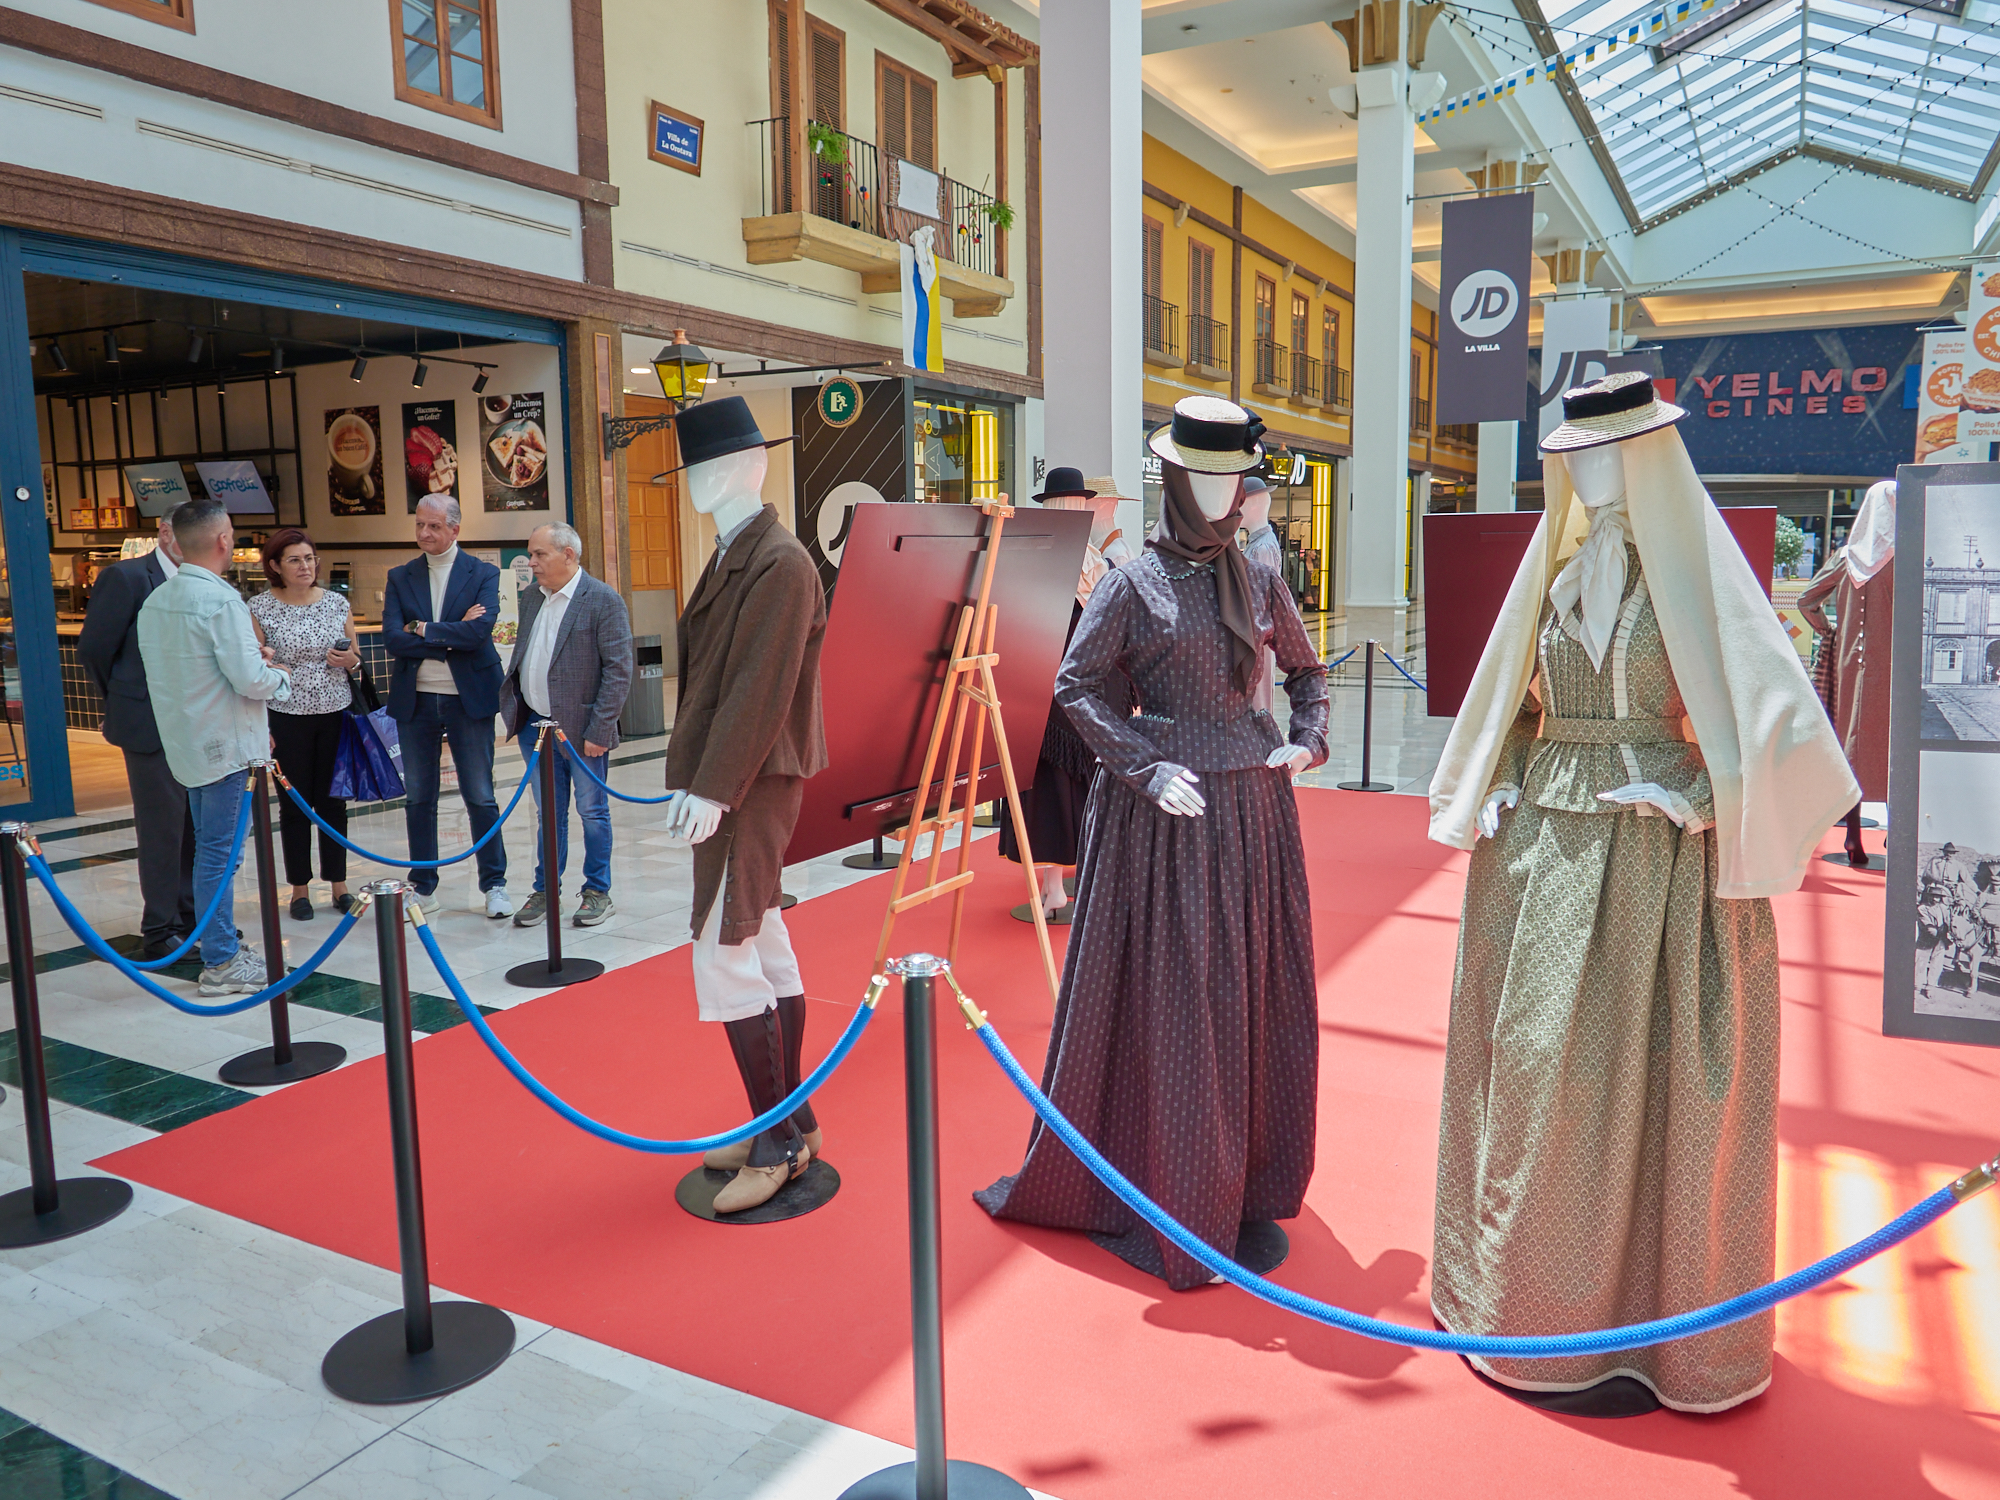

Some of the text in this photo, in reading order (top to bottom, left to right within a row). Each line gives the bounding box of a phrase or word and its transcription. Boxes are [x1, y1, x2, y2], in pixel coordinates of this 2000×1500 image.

[661, 140, 692, 158] La Orotava
[667, 132, 689, 146] Villa de
[1460, 286, 1510, 322] JD
[1465, 343, 1500, 353] LA VILLA
[1693, 366, 1888, 398] YELMO
[522, 408, 541, 419] Crep?
[1707, 395, 1867, 418] CINES
[1289, 453, 1306, 485] JD
